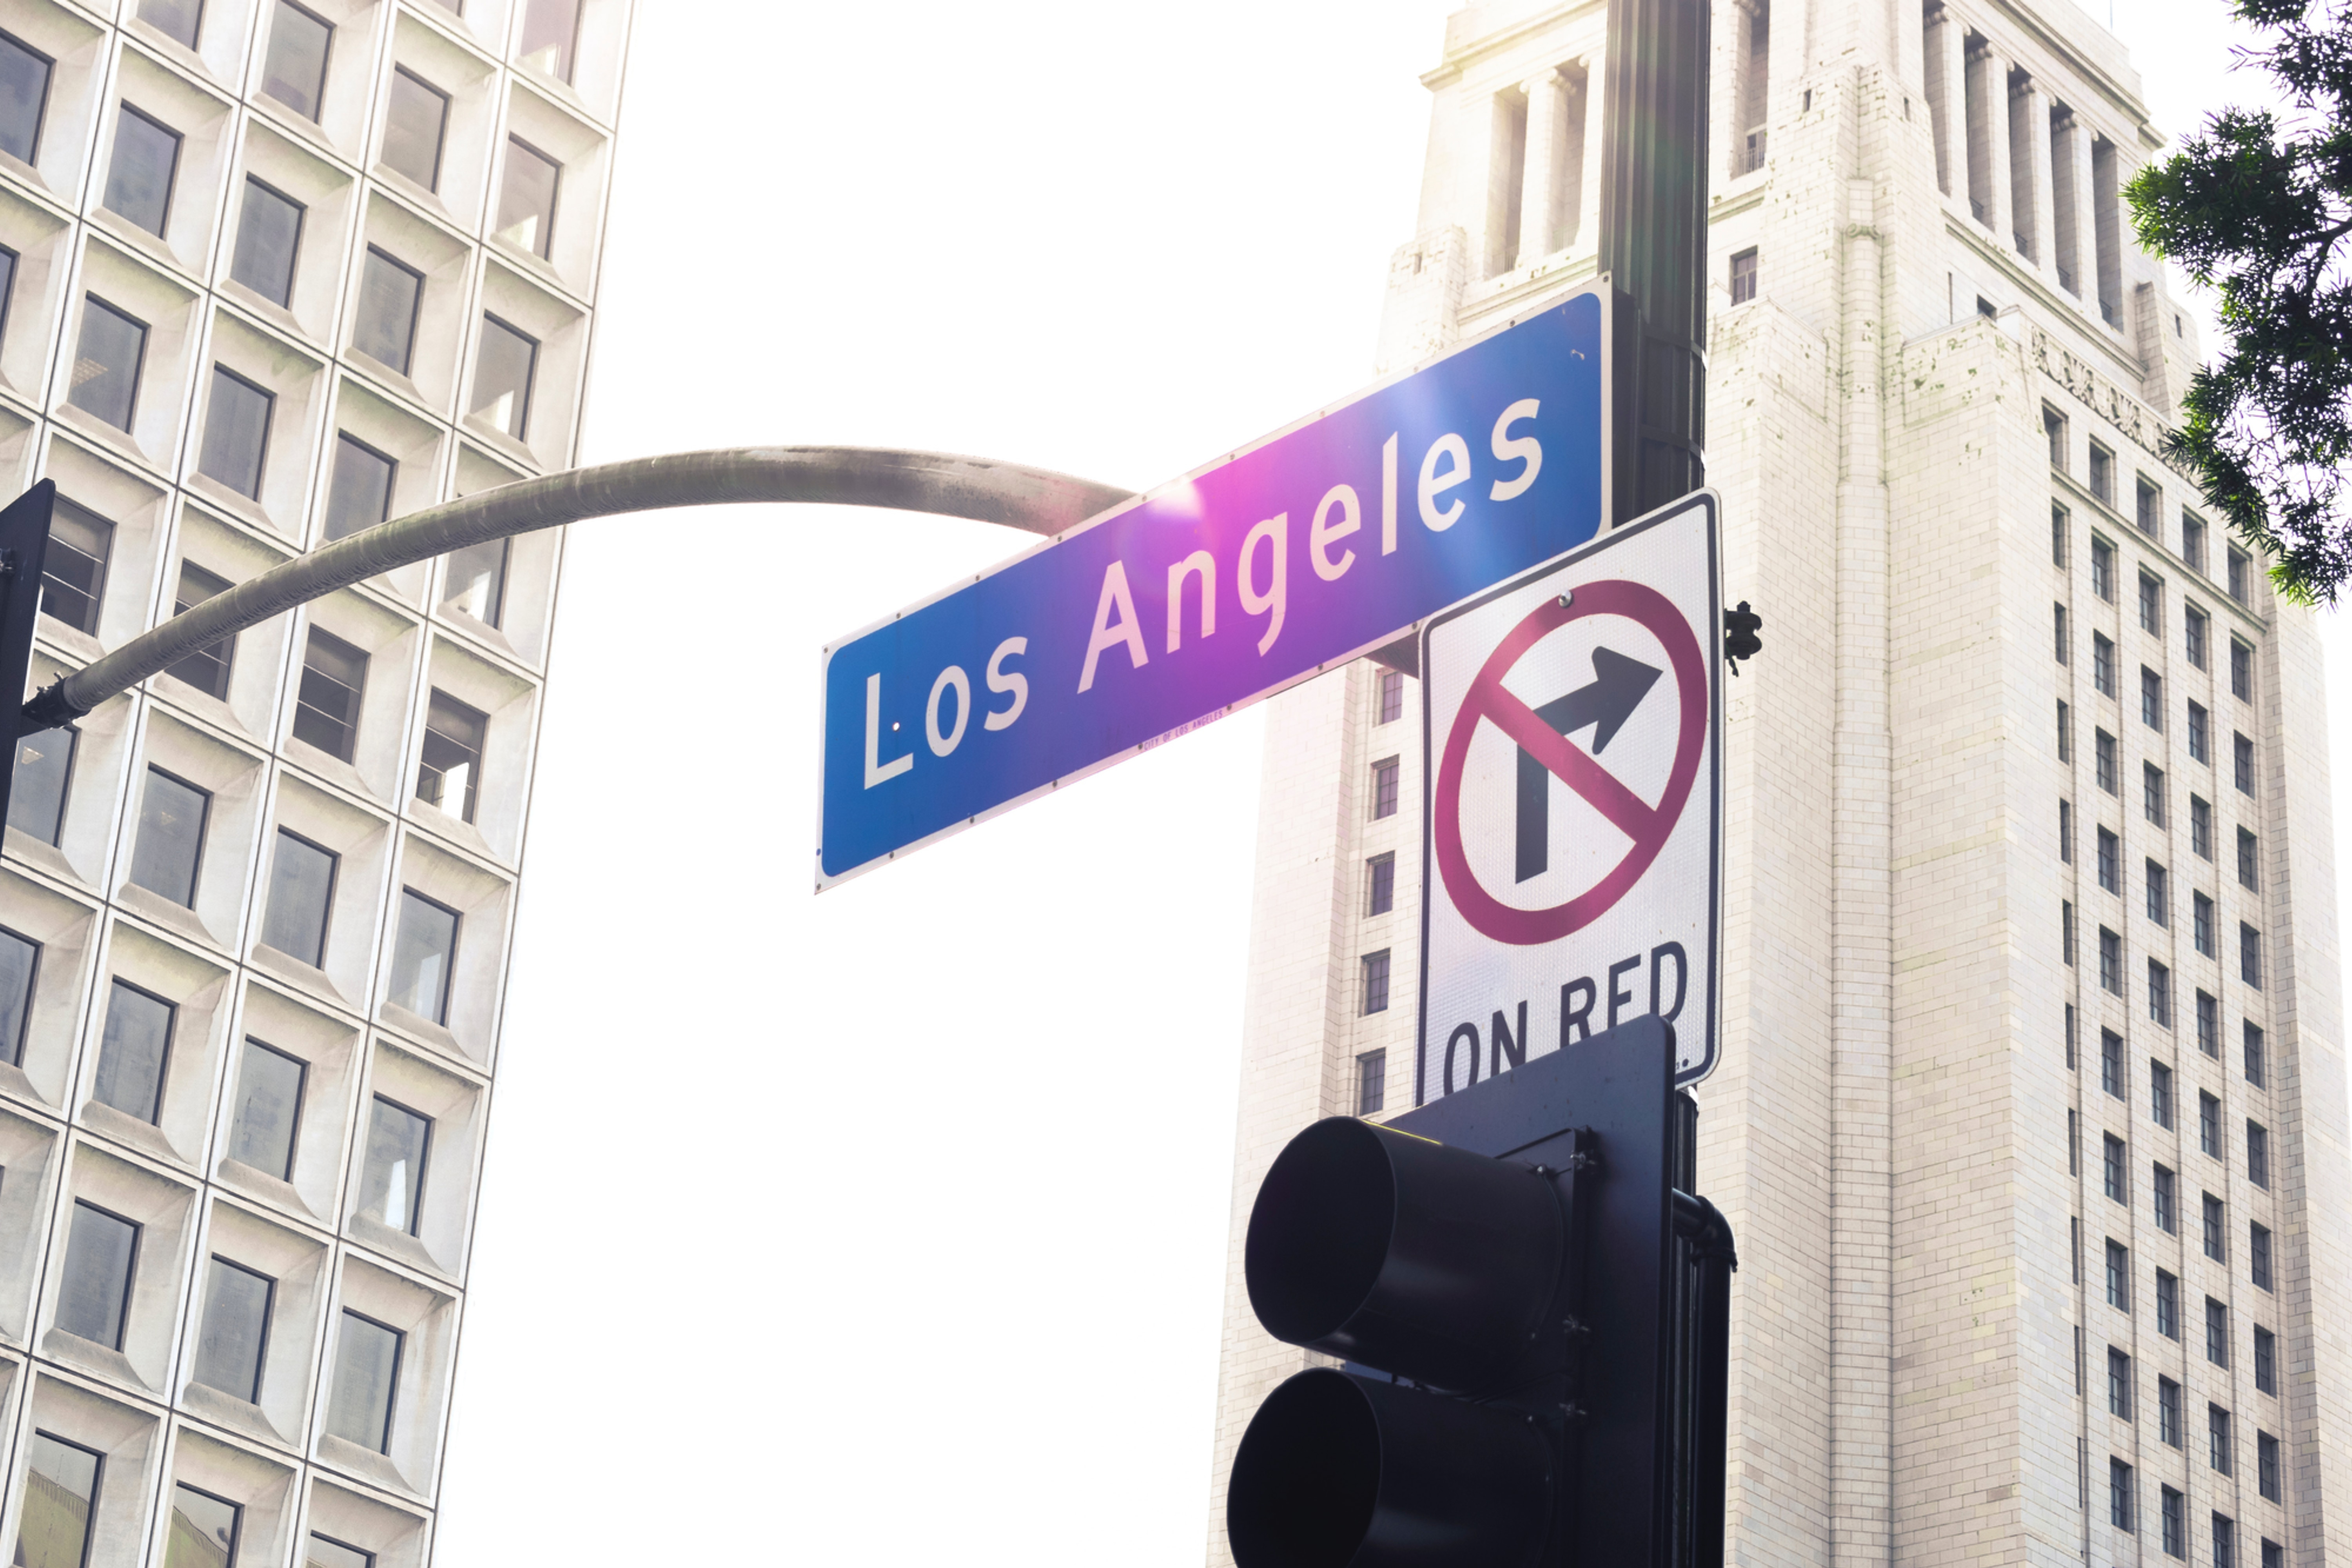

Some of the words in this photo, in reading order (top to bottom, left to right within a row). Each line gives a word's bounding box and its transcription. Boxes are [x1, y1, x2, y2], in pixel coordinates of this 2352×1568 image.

[864, 636, 1029, 790] Los
[1077, 398, 1543, 693] Angeles
[1144, 737, 1159, 751] CITY
[1163, 731, 1172, 742] OF
[1175, 724, 1189, 737] LOS
[1192, 710, 1223, 729] ANGELES
[1443, 1000, 1527, 1096] ON
